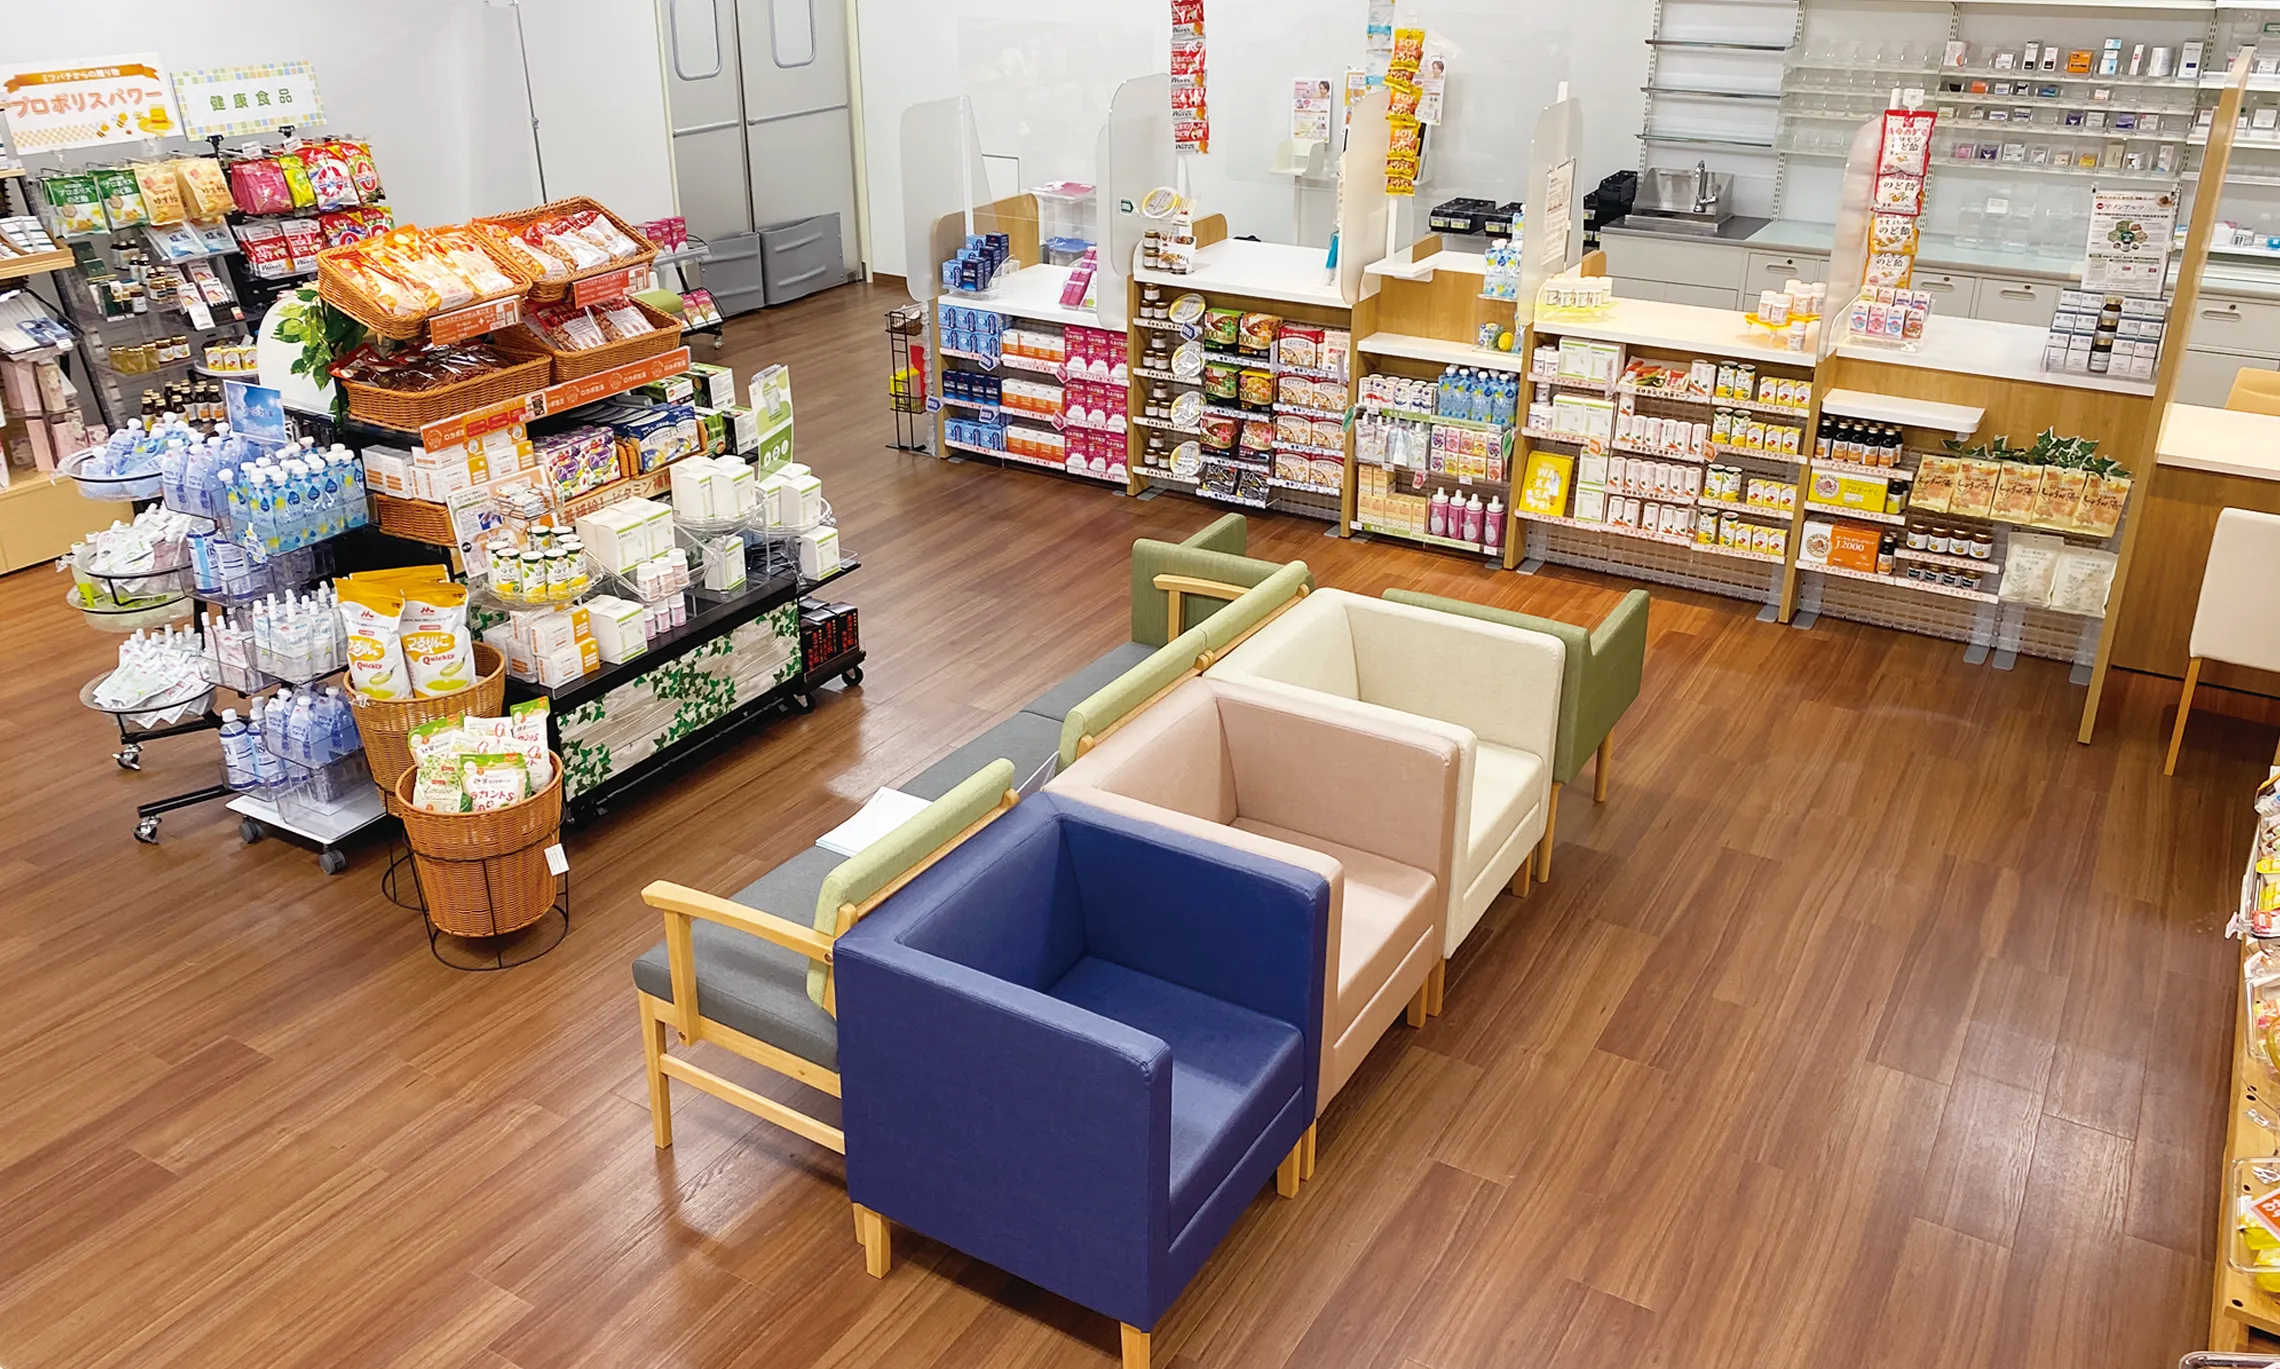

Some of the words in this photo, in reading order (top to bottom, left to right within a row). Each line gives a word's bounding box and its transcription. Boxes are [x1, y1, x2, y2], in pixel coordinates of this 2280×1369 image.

[209, 88, 293, 112] 健康食品
[1884, 181, 1916, 192] のど飴
[1879, 227, 1910, 236] のど飴
[1876, 258, 1904, 268] のど飴
[1834, 539, 1865, 553] J2000
[423, 654, 455, 665] Quickly
[356, 662, 382, 671] Quickly
